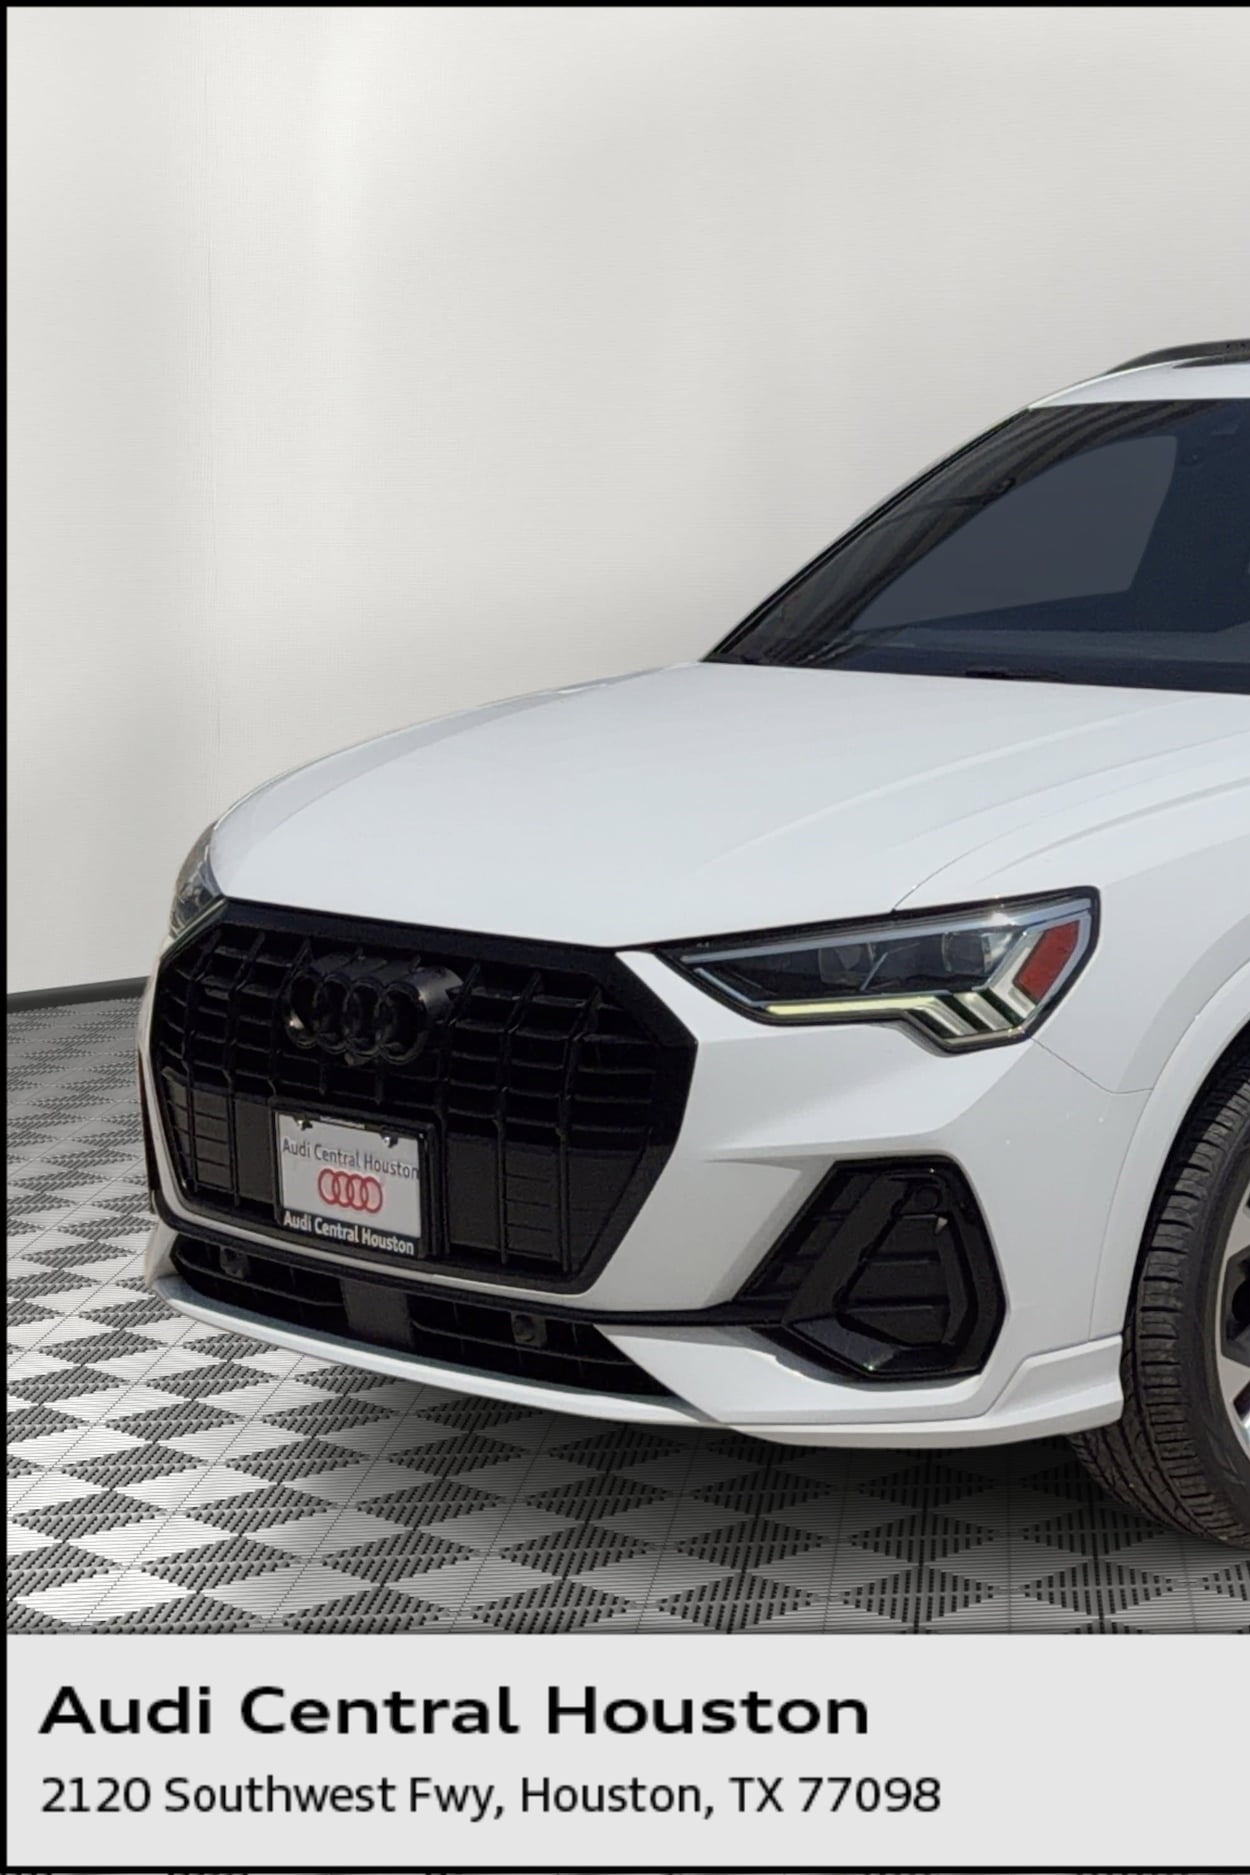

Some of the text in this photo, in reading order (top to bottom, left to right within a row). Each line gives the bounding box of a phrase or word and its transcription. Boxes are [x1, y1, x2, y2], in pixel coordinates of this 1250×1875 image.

[283, 1137, 420, 1180] Audi Central Houston
[283, 1210, 415, 1256] Audi Central Houston
